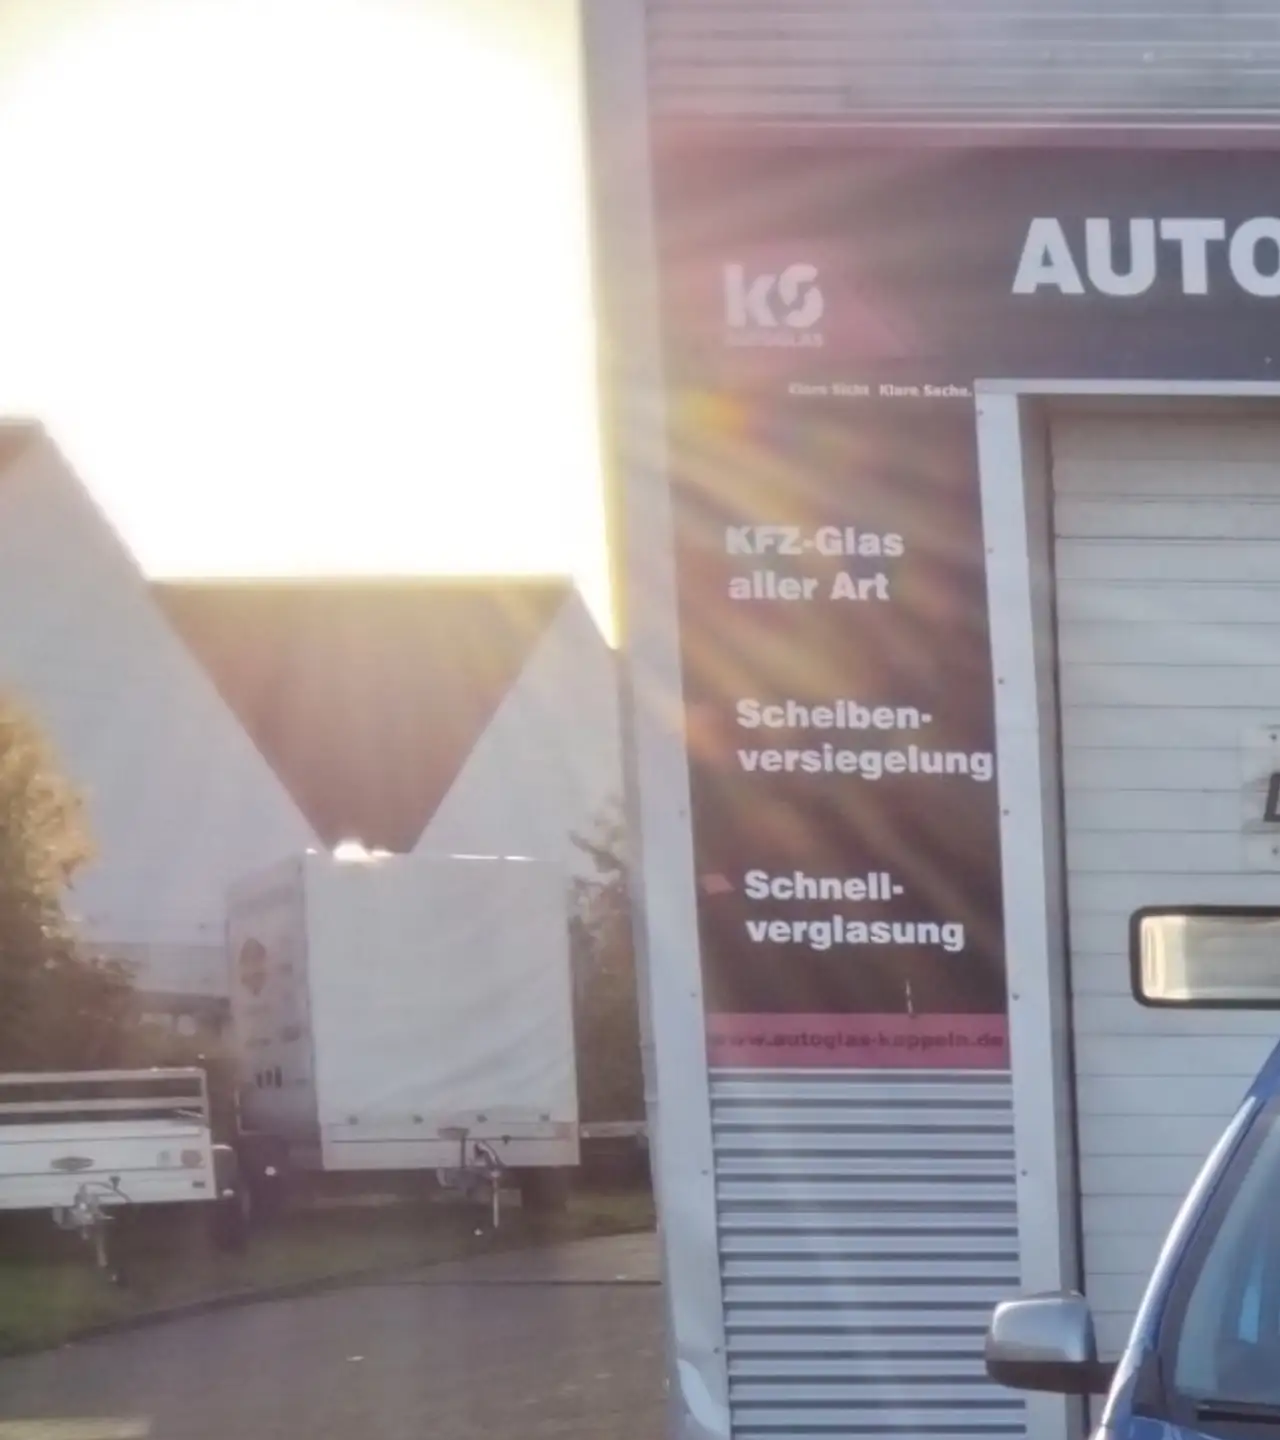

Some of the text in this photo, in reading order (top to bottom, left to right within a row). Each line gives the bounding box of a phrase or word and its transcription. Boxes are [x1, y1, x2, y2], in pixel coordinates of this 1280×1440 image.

[725, 525, 905, 557] KFZ-Glas
[727, 571, 890, 601] aller Art
[736, 698, 932, 730] Scheiben-
[737, 743, 994, 782] versiegelung
[744, 869, 904, 901] Schnell-
[745, 914, 965, 952] verglasung
